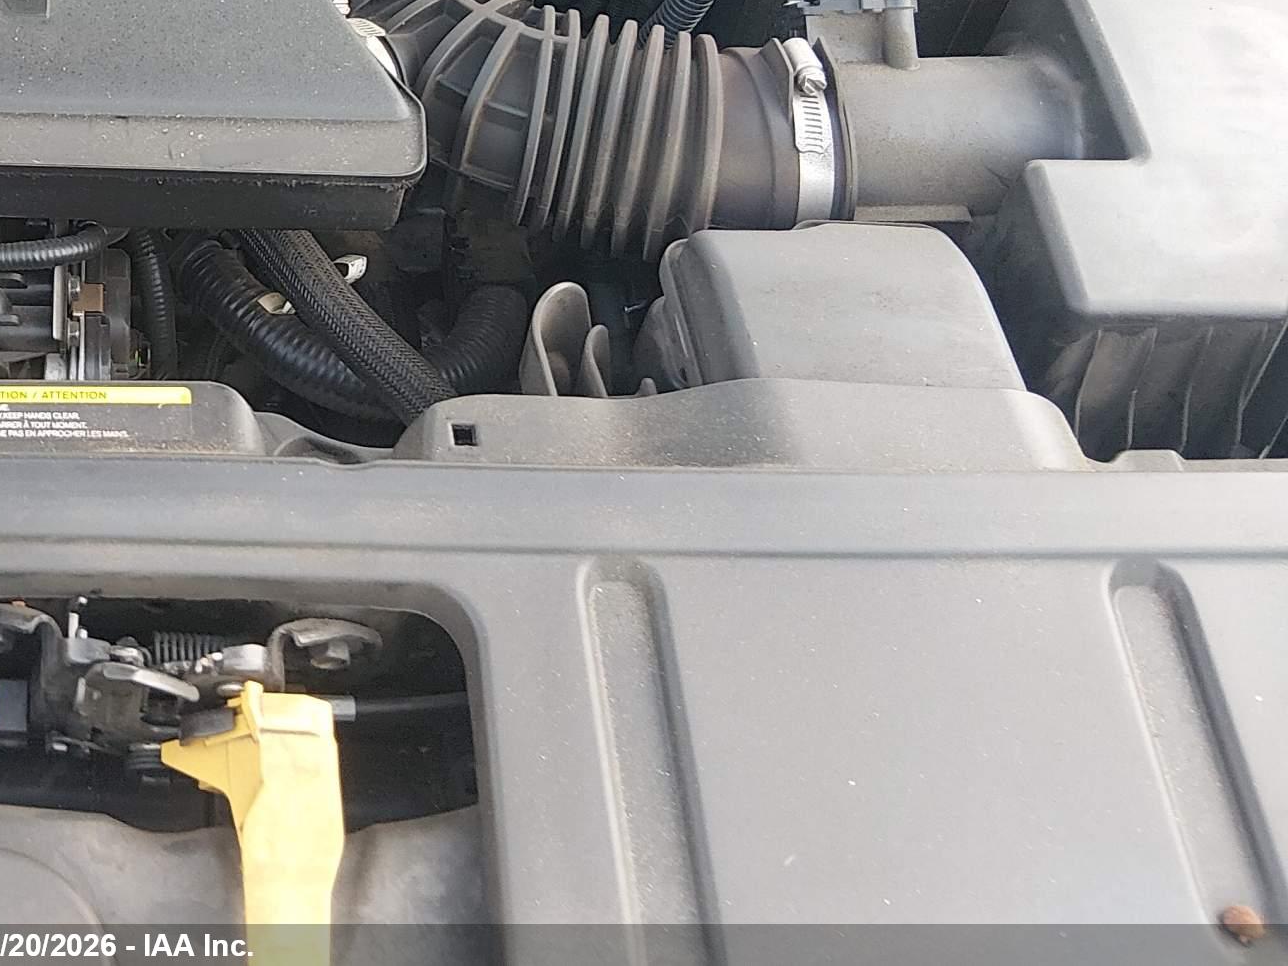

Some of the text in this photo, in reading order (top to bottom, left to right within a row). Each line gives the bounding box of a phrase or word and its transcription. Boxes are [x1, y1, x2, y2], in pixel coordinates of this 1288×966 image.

[42, 391, 107, 400] ATTENTION
[23, 412, 52, 420] HANDS
[31, 420, 51, 429] TOUT
[7, 429, 24, 438] PAS
[24, 429, 37, 438] EN
[37, 429, 87, 438] APPROCHER
[87, 429, 102, 438] LES
